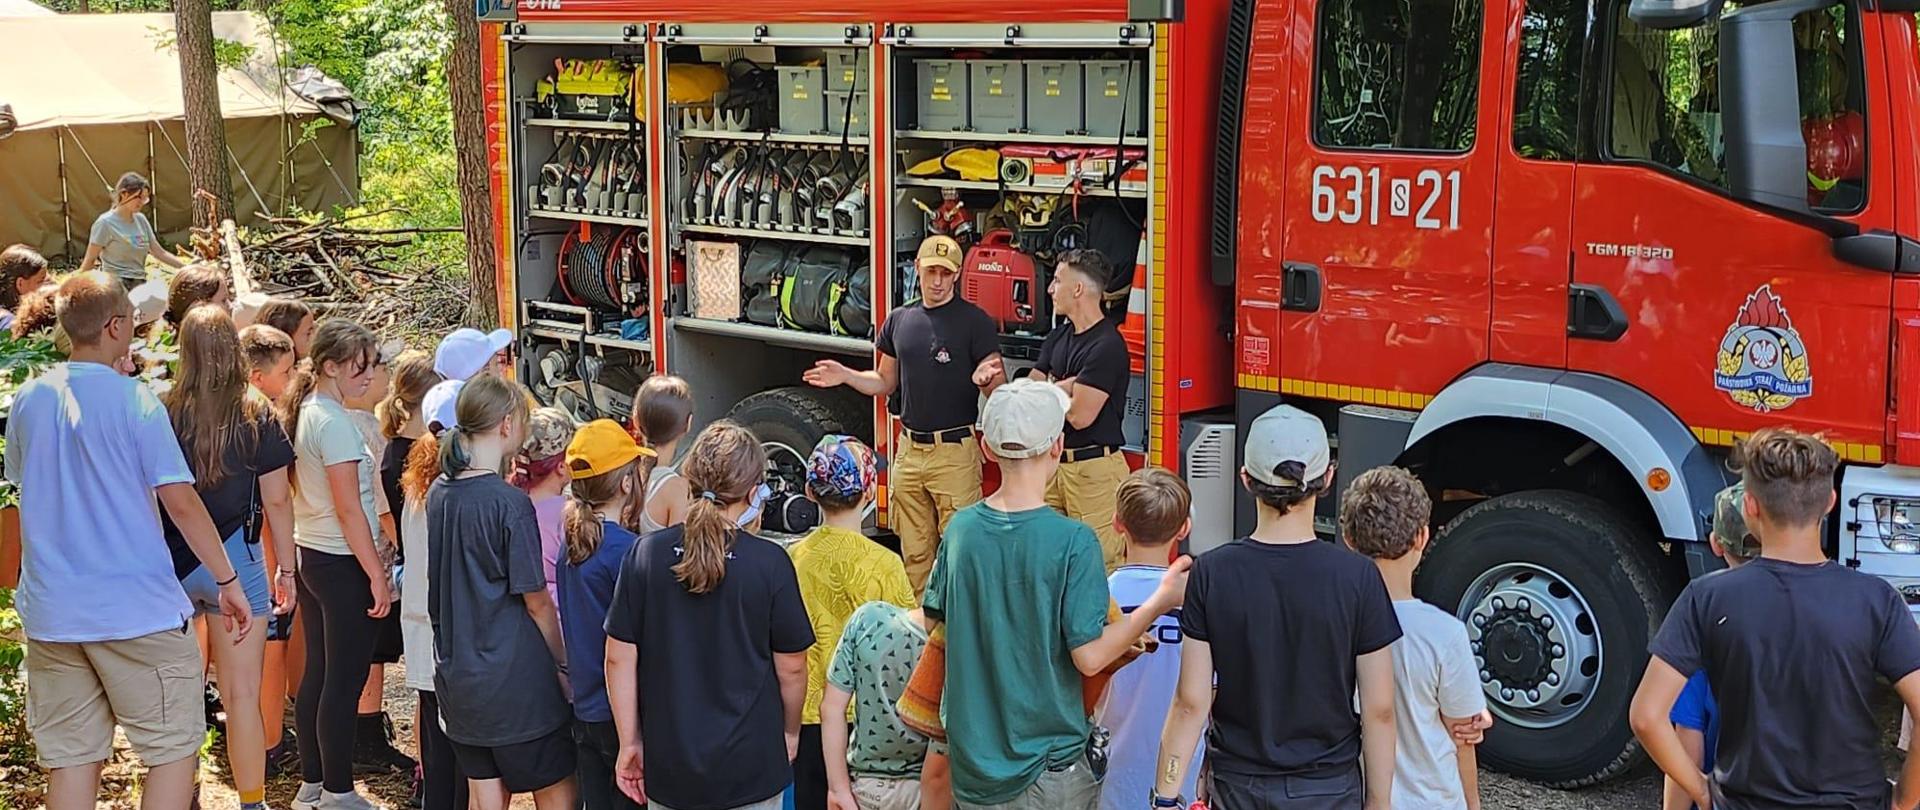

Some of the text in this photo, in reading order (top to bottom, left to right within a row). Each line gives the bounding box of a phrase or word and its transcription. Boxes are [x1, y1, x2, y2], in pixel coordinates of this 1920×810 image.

[1312, 165, 1380, 226] 631
[1415, 168, 1461, 230] 21
[1586, 242, 1618, 257] TGM
